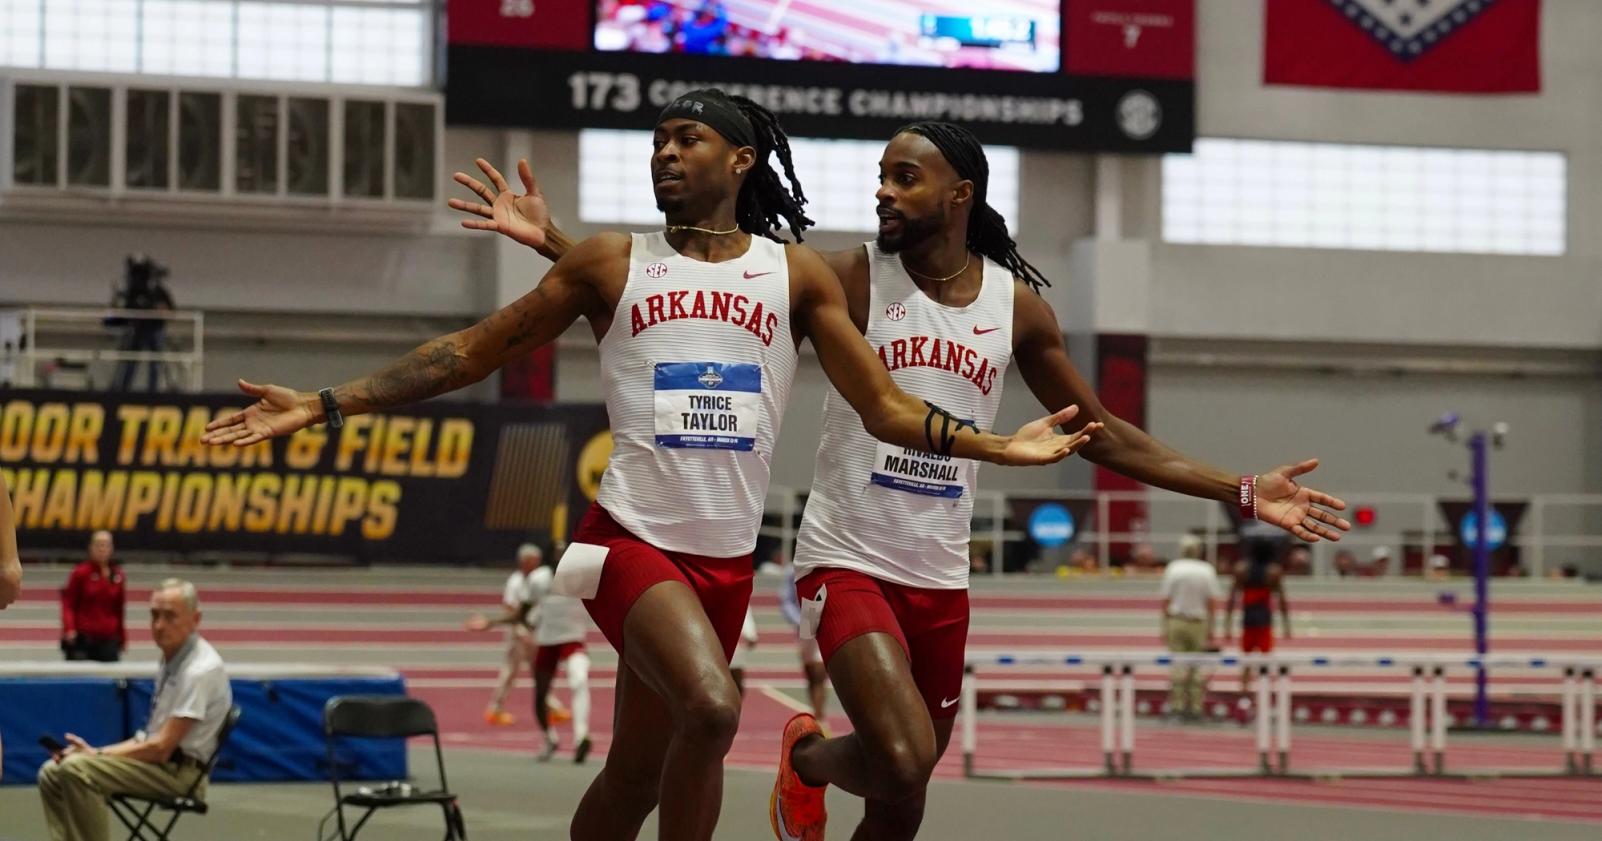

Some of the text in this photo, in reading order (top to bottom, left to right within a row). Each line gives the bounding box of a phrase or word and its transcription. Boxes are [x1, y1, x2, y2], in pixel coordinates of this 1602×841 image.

[567, 72, 641, 112] 173
[646, 263, 668, 278] SEC
[631, 290, 778, 347] ARKANSAS
[886, 302, 906, 320] SEC
[688, 395, 732, 411] TYRICE
[681, 413, 738, 432] TAYLOR
[334, 413, 475, 478] FIELD
[884, 455, 958, 481] MARSHALL
